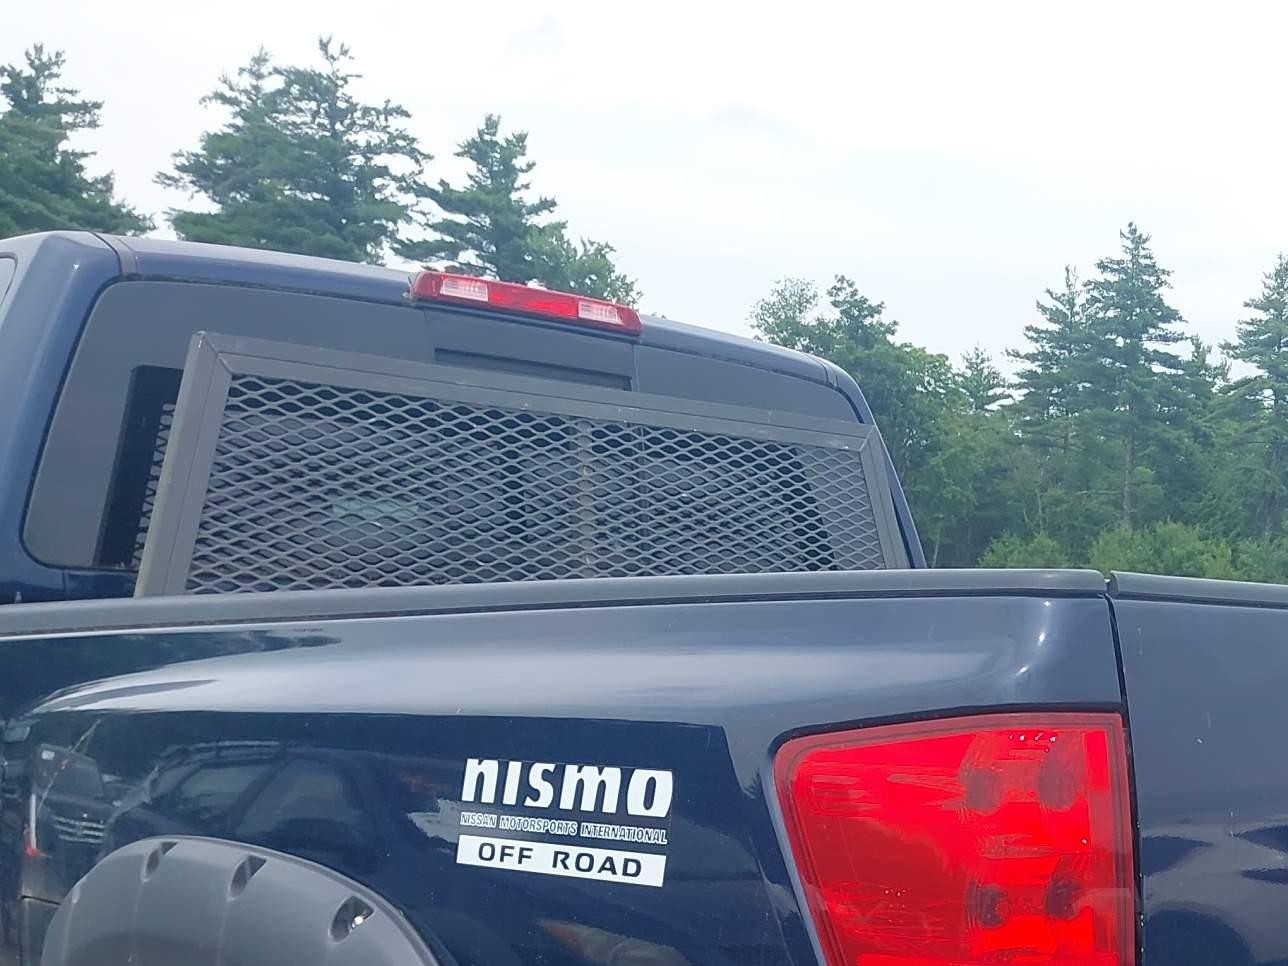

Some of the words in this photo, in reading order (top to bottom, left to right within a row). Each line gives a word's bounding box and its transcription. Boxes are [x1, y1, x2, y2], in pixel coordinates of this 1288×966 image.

[461, 757, 674, 818] nismo
[460, 812, 498, 829] NISSAN
[499, 815, 578, 836] MOTORSPORTS
[579, 822, 668, 845] INTERNATIONAL
[477, 841, 534, 866] OFF
[551, 850, 643, 878] ROAD
